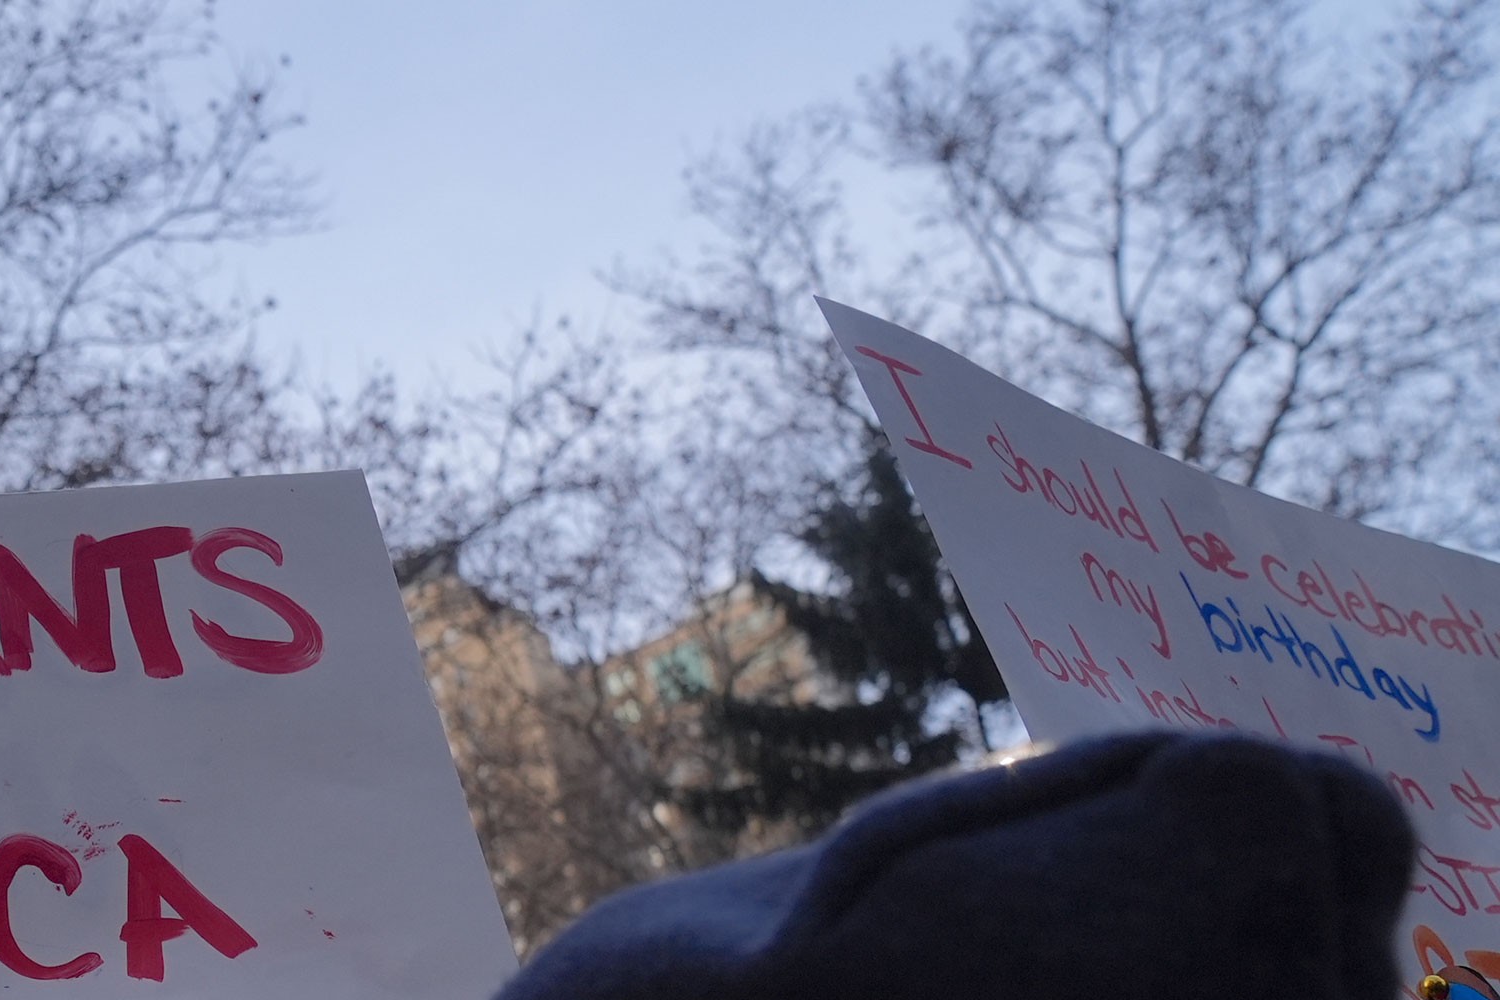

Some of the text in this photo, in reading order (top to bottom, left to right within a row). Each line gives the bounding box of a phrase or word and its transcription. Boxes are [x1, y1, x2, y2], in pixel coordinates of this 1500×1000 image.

[855, 345, 1500, 666] I should be celebrati
[1004, 603, 1122, 703] but
[1080, 552, 1441, 743] my birthday
